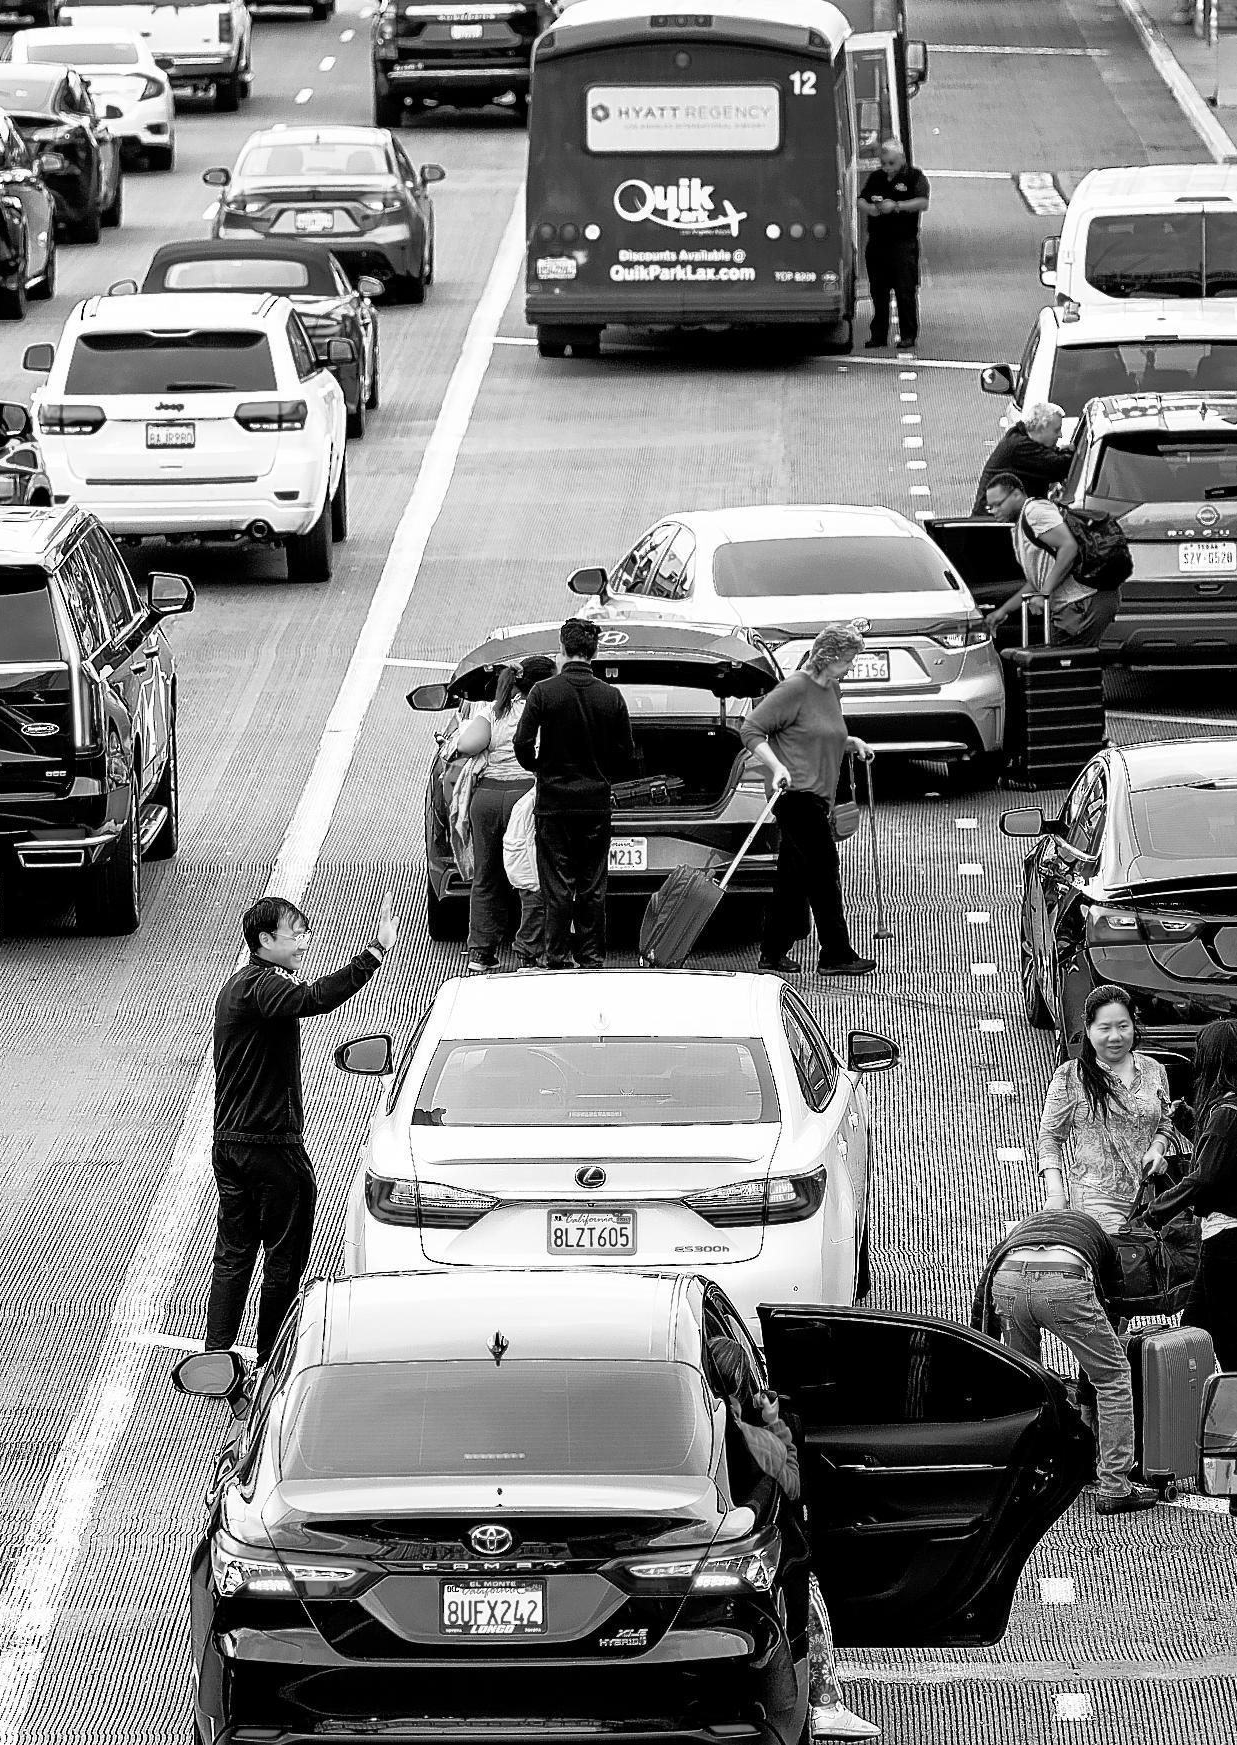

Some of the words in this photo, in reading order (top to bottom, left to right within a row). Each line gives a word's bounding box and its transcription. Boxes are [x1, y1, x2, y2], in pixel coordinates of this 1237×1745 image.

[789, 71, 817, 95] 12
[618, 105, 679, 120] HYATT
[685, 105, 772, 120] REGENCY
[614, 178, 715, 222] Quik
[667, 208, 709, 223] Park
[618, 249, 677, 262] Discounts
[679, 249, 732, 262] Available
[609, 264, 756, 282] QuikParkLax.com
[155, 402, 185, 412] Jeep
[565, 1213, 615, 1226] California
[553, 1227, 629, 1248] 8LZT605
[674, 1245, 730, 1253] ES300h
[447, 1599, 538, 1626] 8UFX242
